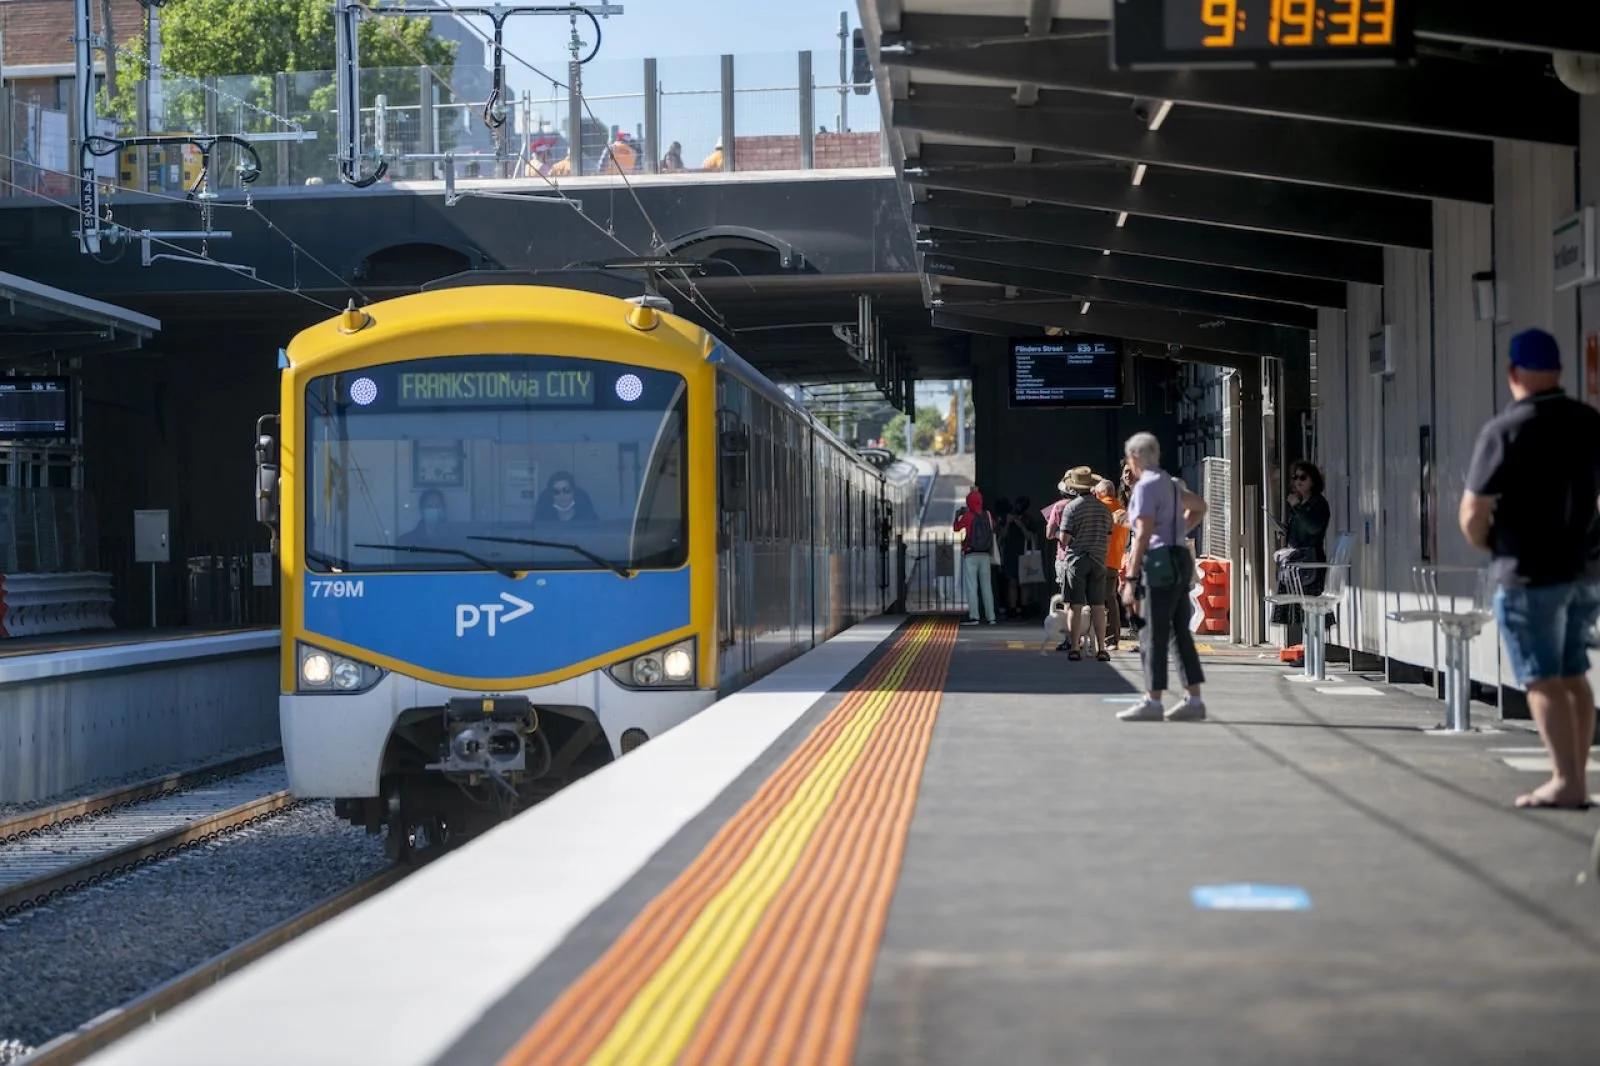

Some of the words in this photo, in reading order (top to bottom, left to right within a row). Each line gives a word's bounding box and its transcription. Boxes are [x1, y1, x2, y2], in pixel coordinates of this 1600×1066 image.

[1201, 0, 1394, 46] 9:19:33
[546, 371, 591, 397] CITY
[310, 580, 364, 598] 779M
[456, 604, 504, 637] PT
